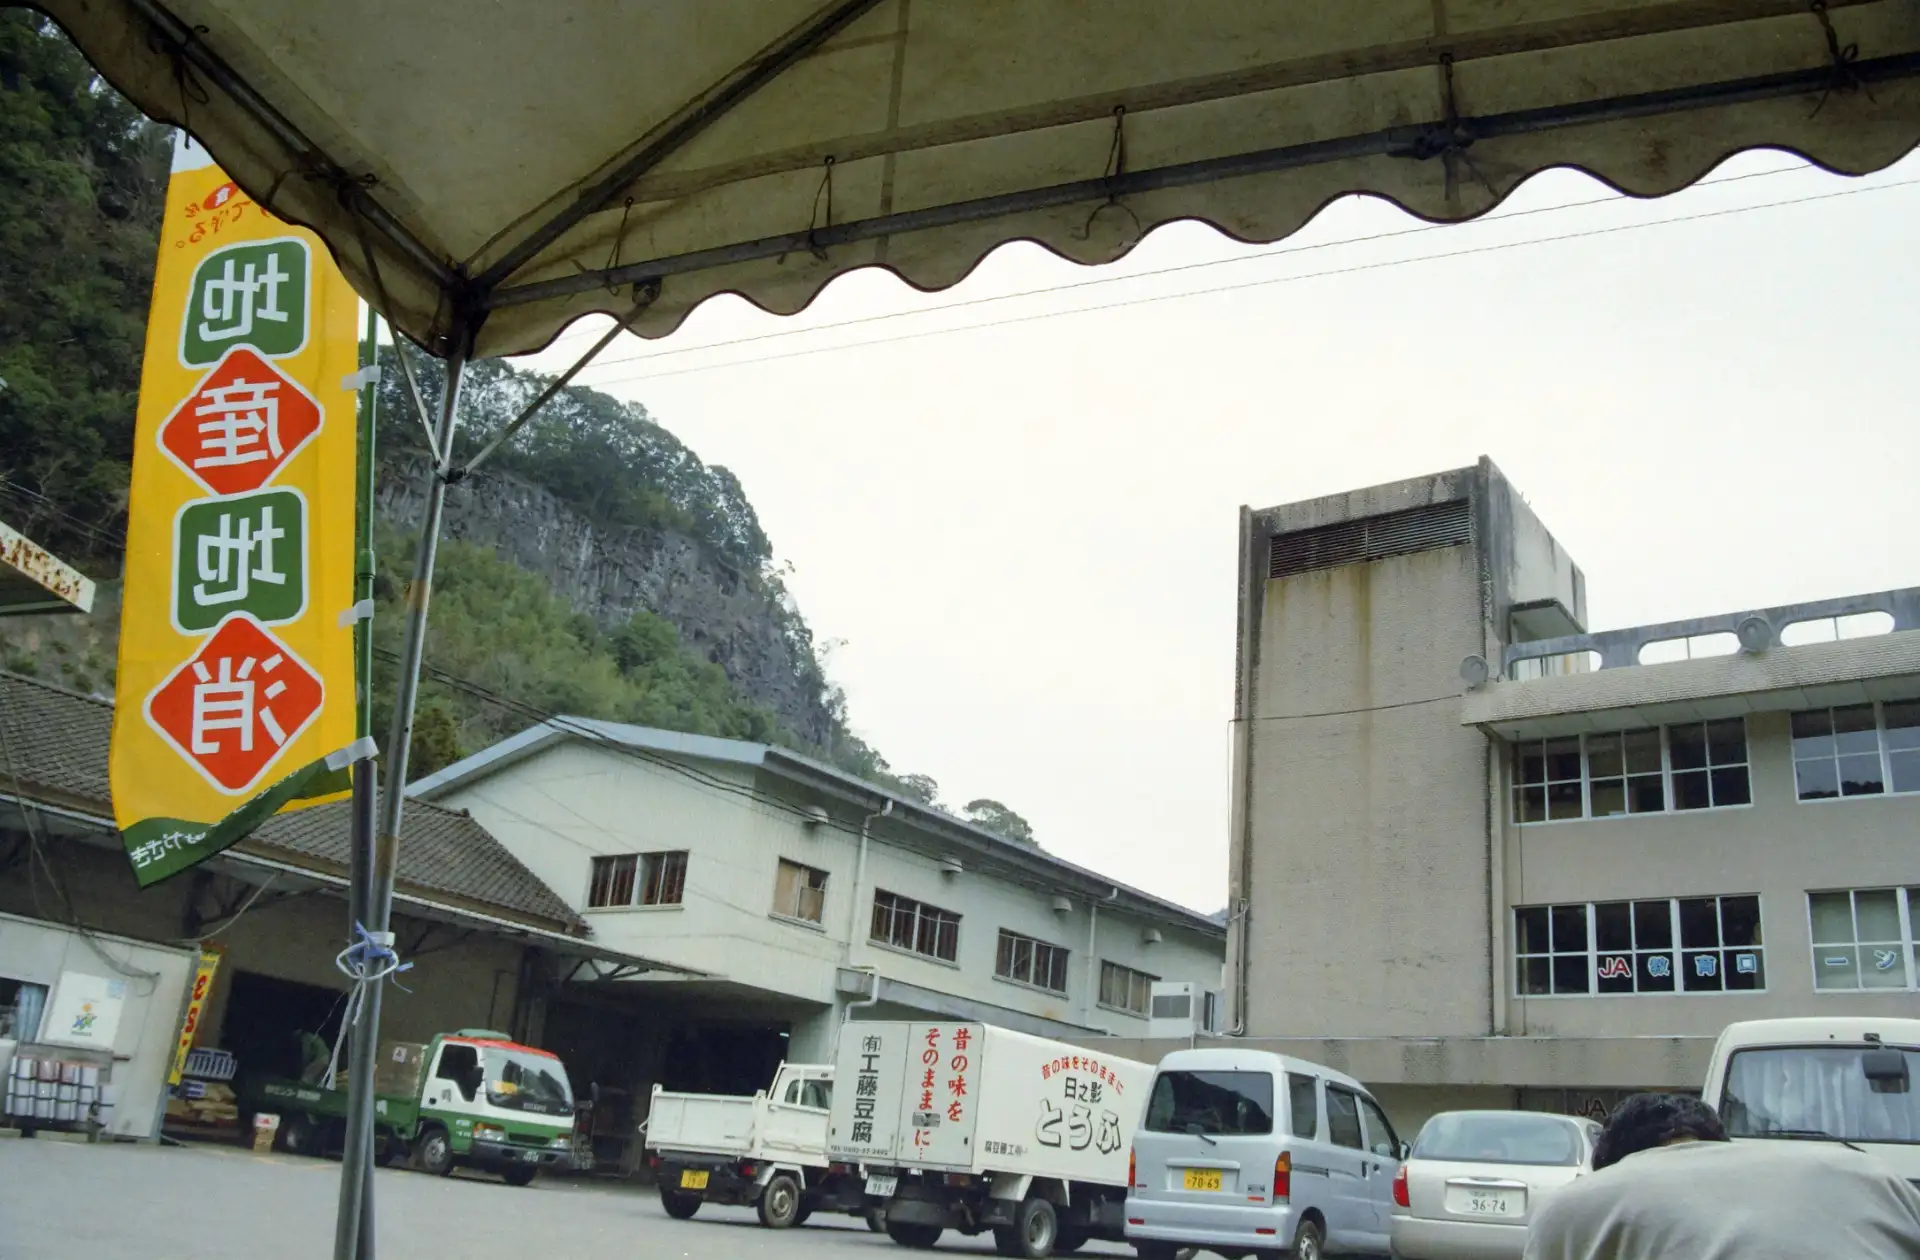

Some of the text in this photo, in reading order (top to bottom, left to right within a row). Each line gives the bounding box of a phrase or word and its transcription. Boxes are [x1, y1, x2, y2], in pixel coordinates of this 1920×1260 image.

[946, 1027, 973, 1122] 昔の味を
[1042, 1056, 1125, 1096] 昔の味をそのままに
[1064, 1076, 1102, 1104] 日之影
[1034, 1097, 1122, 1155] とうふ
